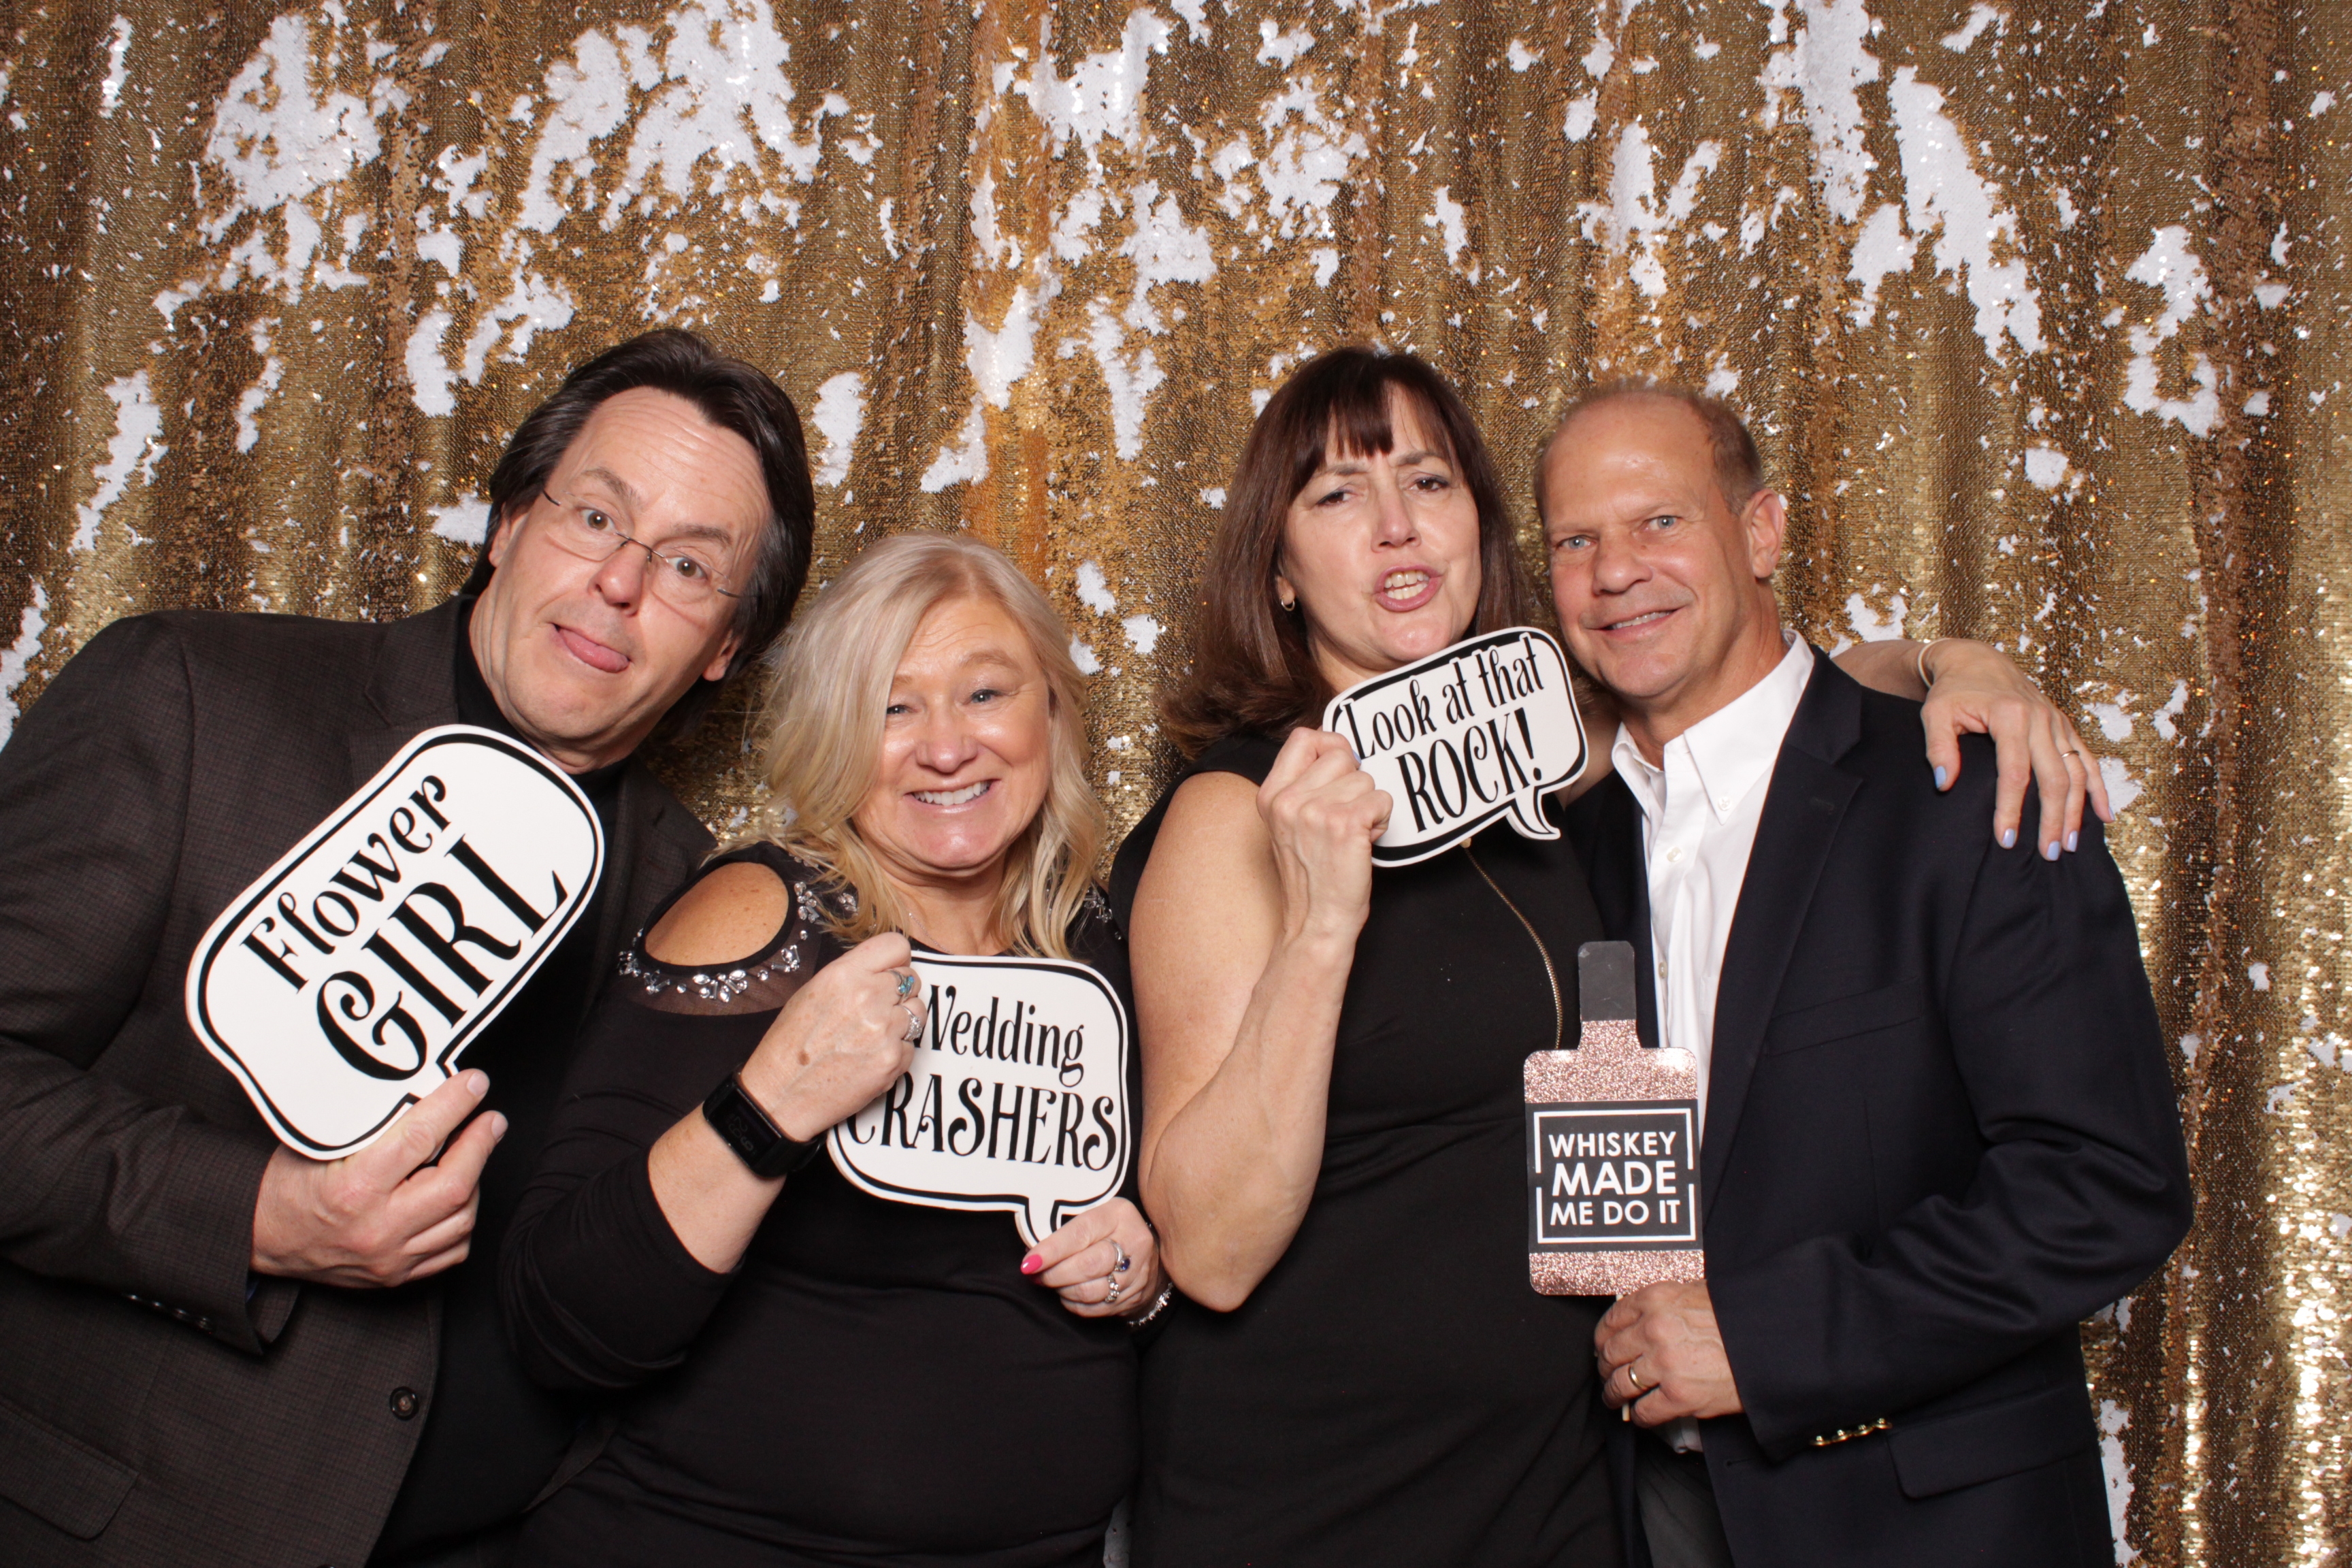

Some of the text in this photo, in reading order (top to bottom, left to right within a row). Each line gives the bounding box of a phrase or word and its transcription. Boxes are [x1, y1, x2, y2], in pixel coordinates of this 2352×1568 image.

[1343, 636, 1545, 760] Look at that
[1394, 707, 1542, 833] ROCK!
[239, 774, 452, 994] Flower
[316, 833, 568, 1081] GIRL
[1548, 1131, 1676, 1157] WHISKEY
[1552, 1160, 1676, 1196] MADE
[1550, 1199, 1680, 1226] ME DO IT
